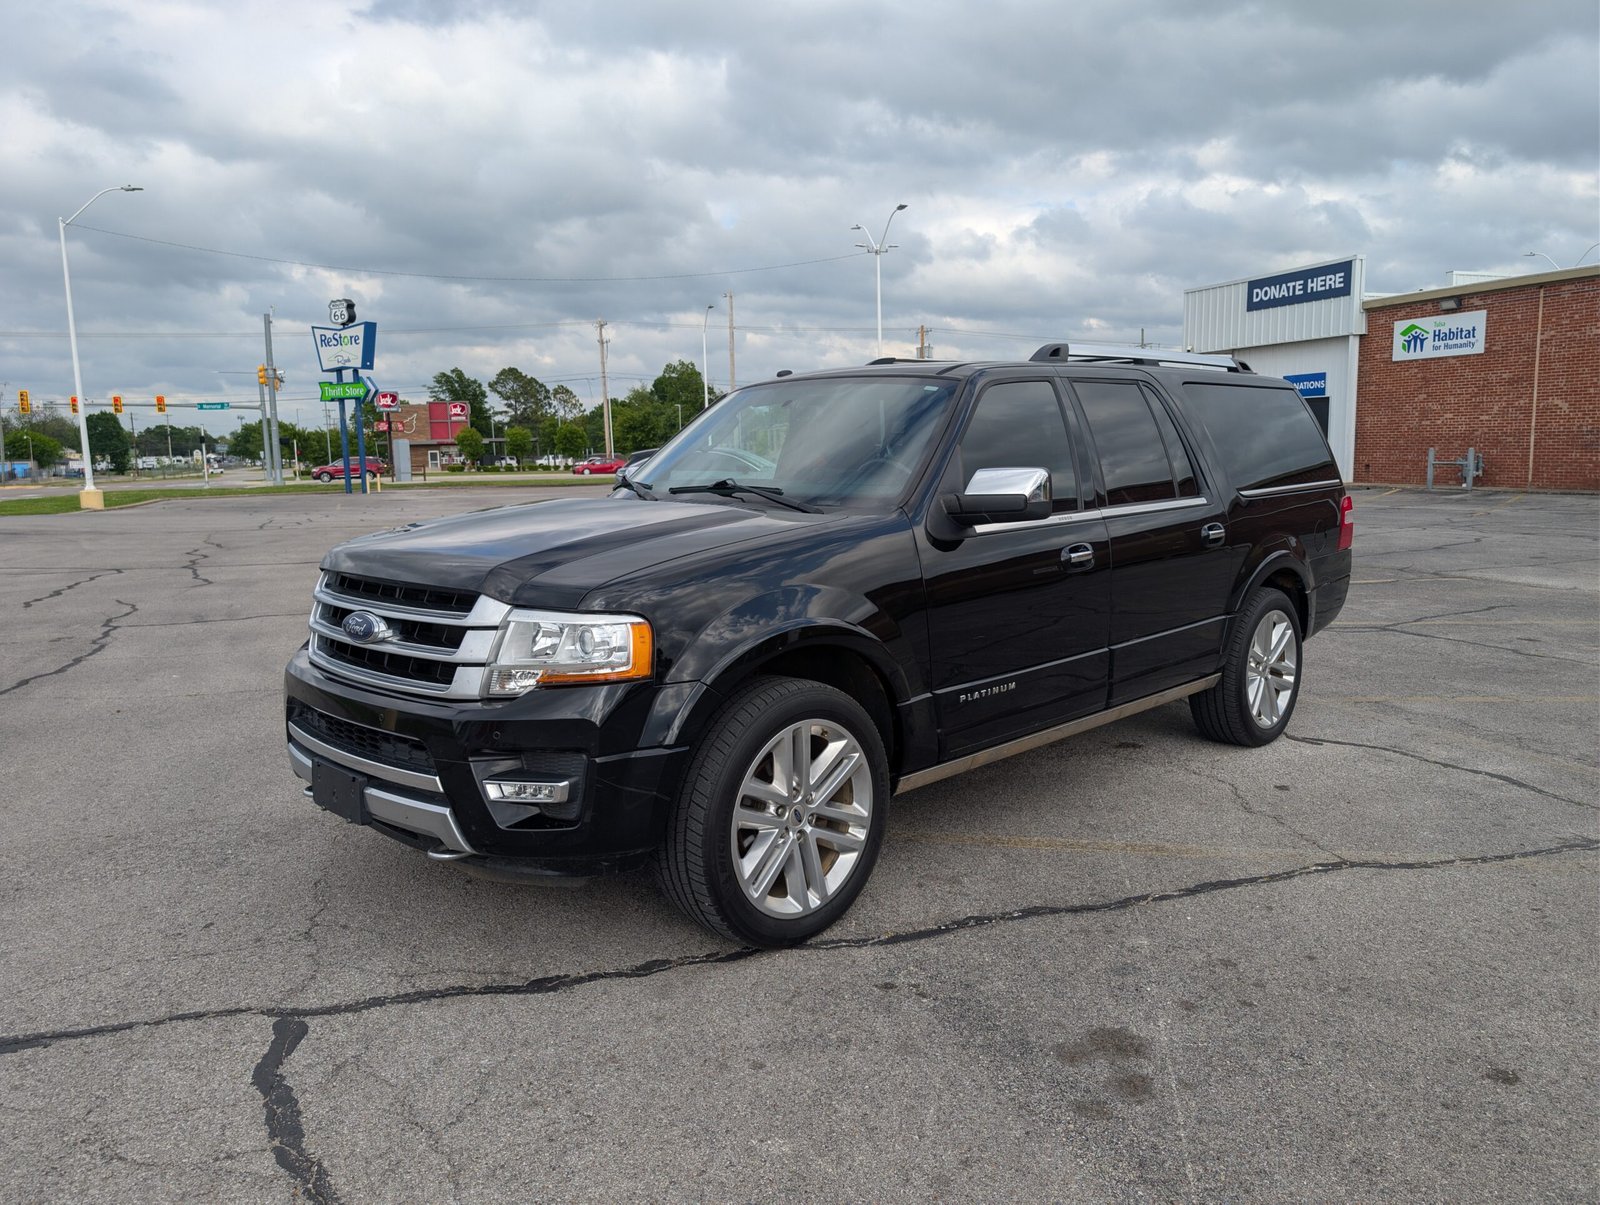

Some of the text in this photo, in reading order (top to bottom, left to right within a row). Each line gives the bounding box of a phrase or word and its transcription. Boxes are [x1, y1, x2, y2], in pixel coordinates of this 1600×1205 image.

[1253, 272, 1345, 303] DONATE HERE
[333, 309, 346, 321] 66
[319, 333, 360, 348] ReStore
[1432, 326, 1477, 342] Habitat
[1432, 340, 1476, 352] for Humanity
[324, 385, 365, 397] Thrift Store
[1293, 380, 1325, 390] NATIONS
[345, 616, 367, 636] Ford
[959, 681, 1016, 703] PLATINUM
